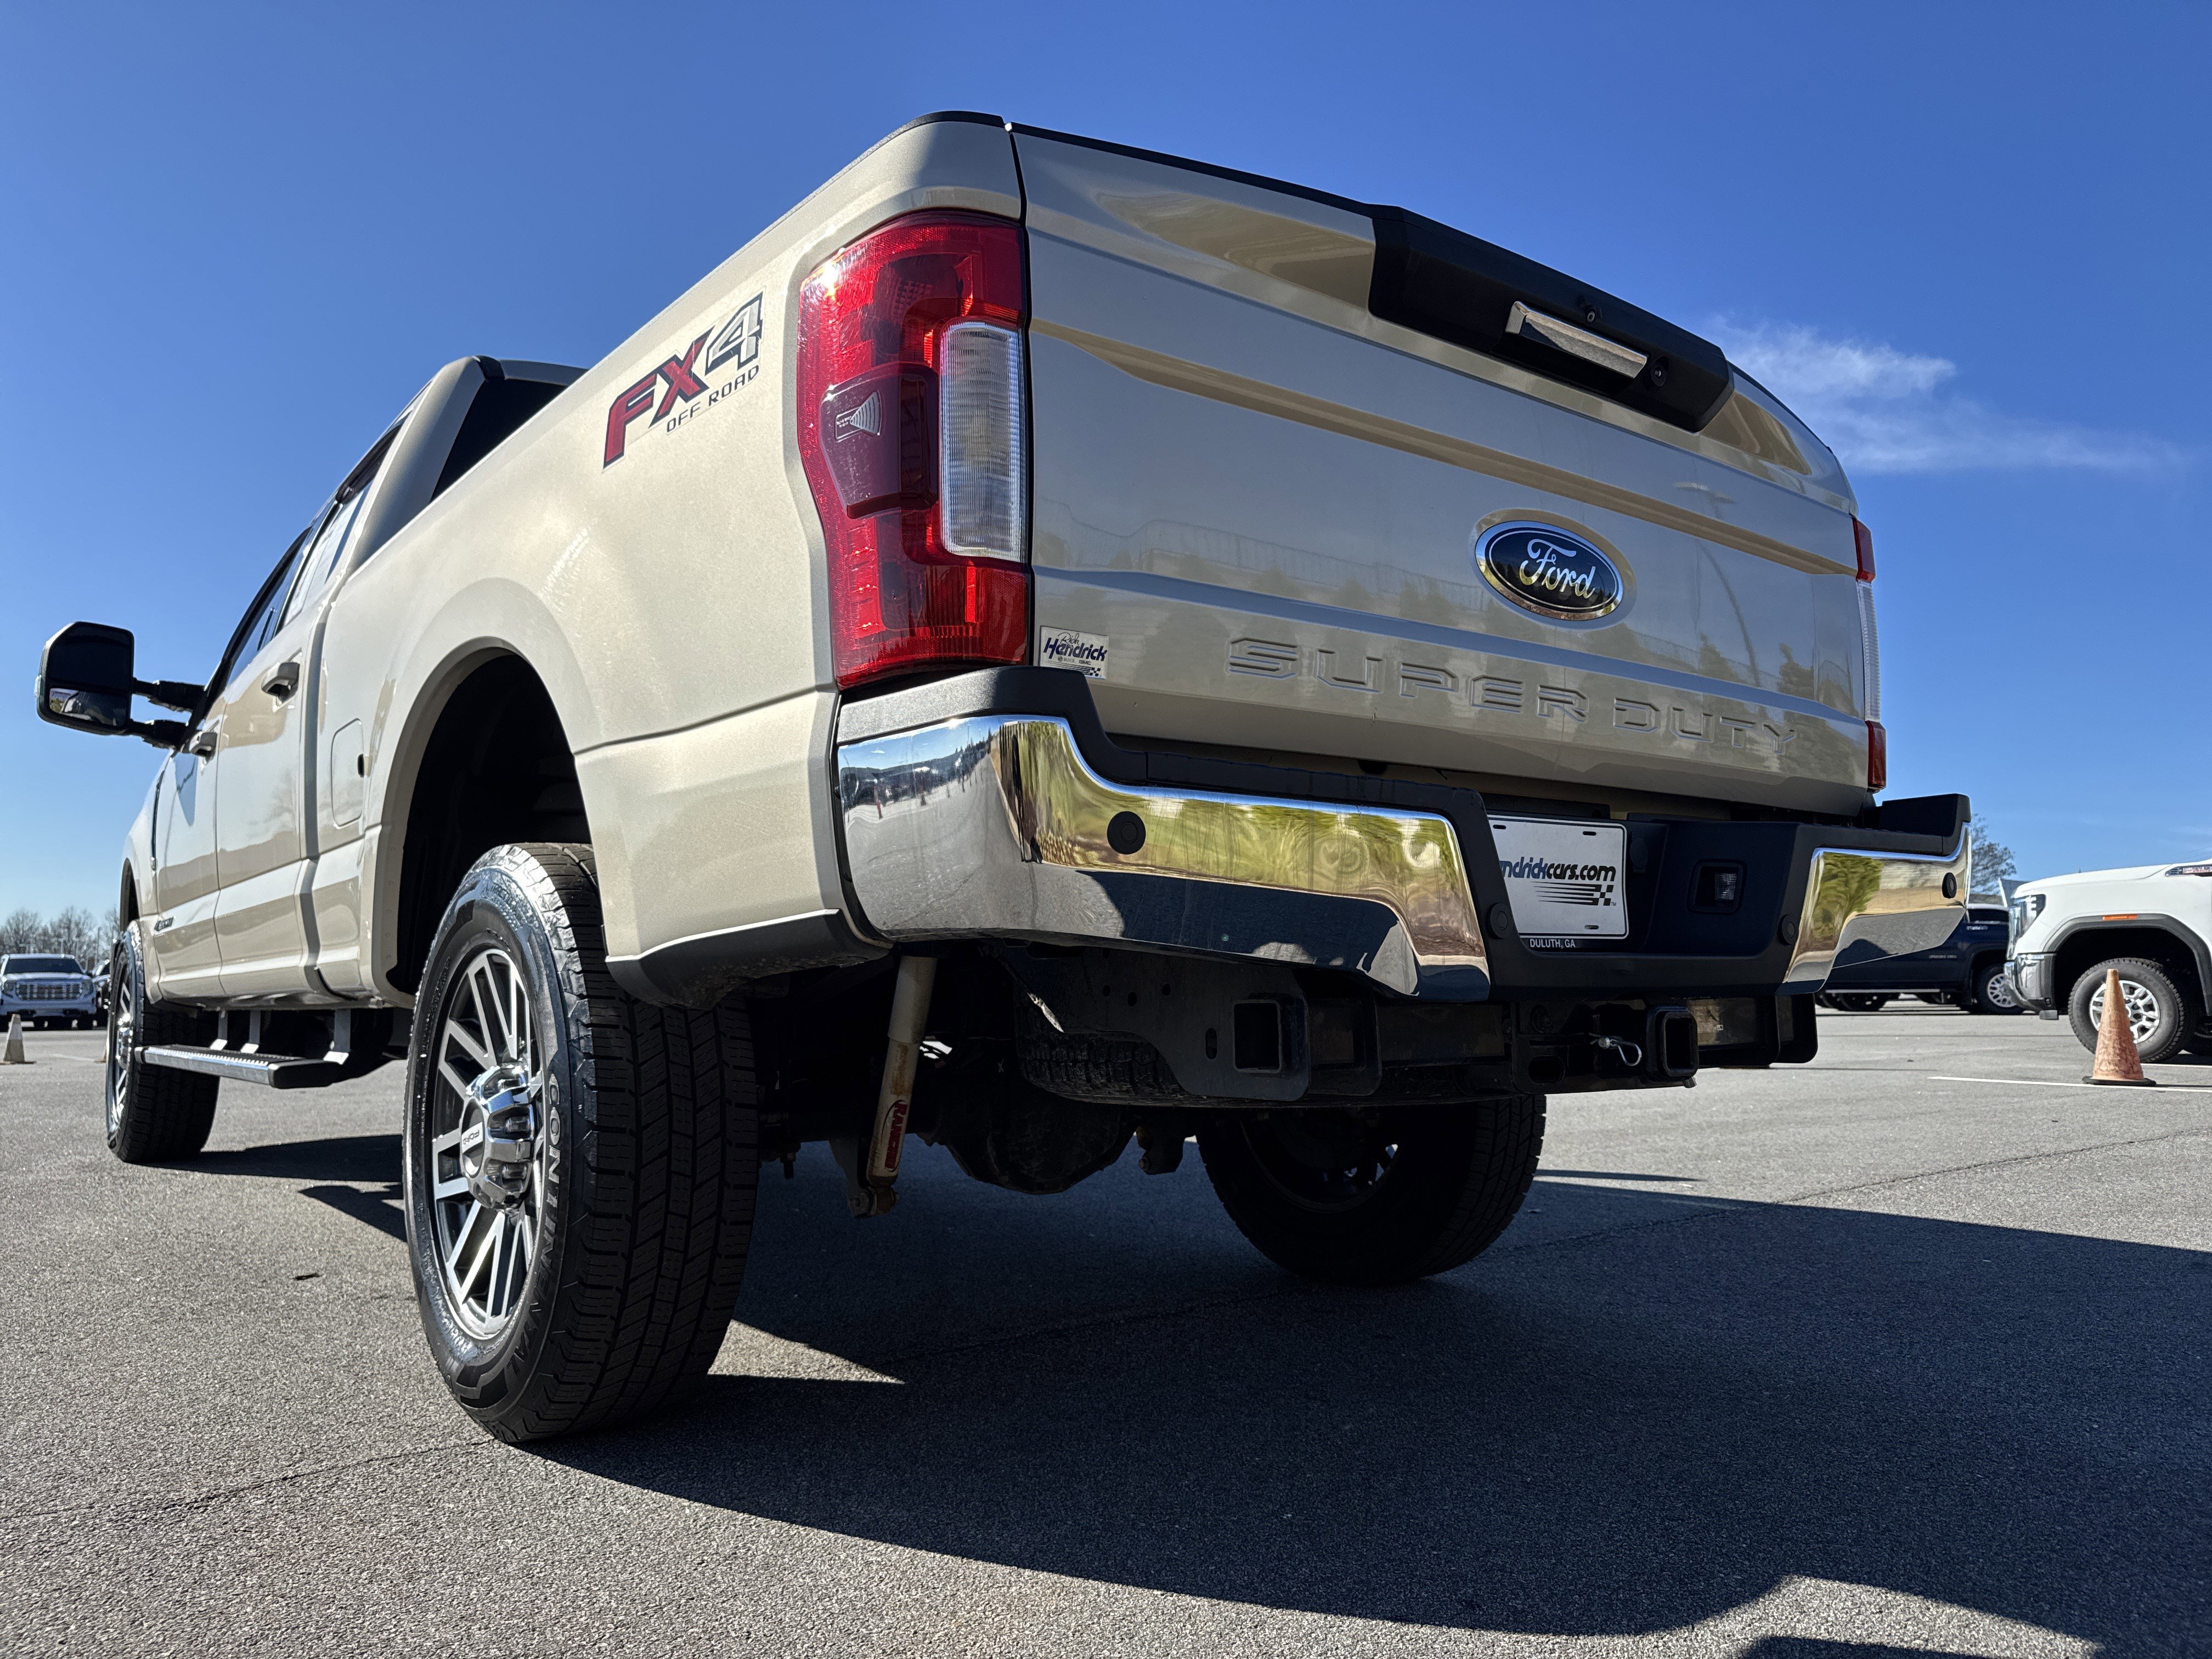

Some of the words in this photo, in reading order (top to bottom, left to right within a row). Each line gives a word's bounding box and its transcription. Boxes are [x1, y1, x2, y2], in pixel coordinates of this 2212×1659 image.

[603, 291, 764, 469] FX4
[667, 401, 701, 433] OFF
[708, 364, 760, 407] ROAD
[1519, 538, 1596, 599] Ford
[1043, 637, 1108, 662] Hendrick
[1226, 636, 1589, 724] SUPER
[1612, 697, 1797, 755] DUTY
[1499, 856, 1617, 882] ndrickcars.com
[1529, 938, 1564, 949] DULUTH,
[1564, 940, 1576, 949] GA
[506, 1073, 561, 1378] CONTINENTAL
